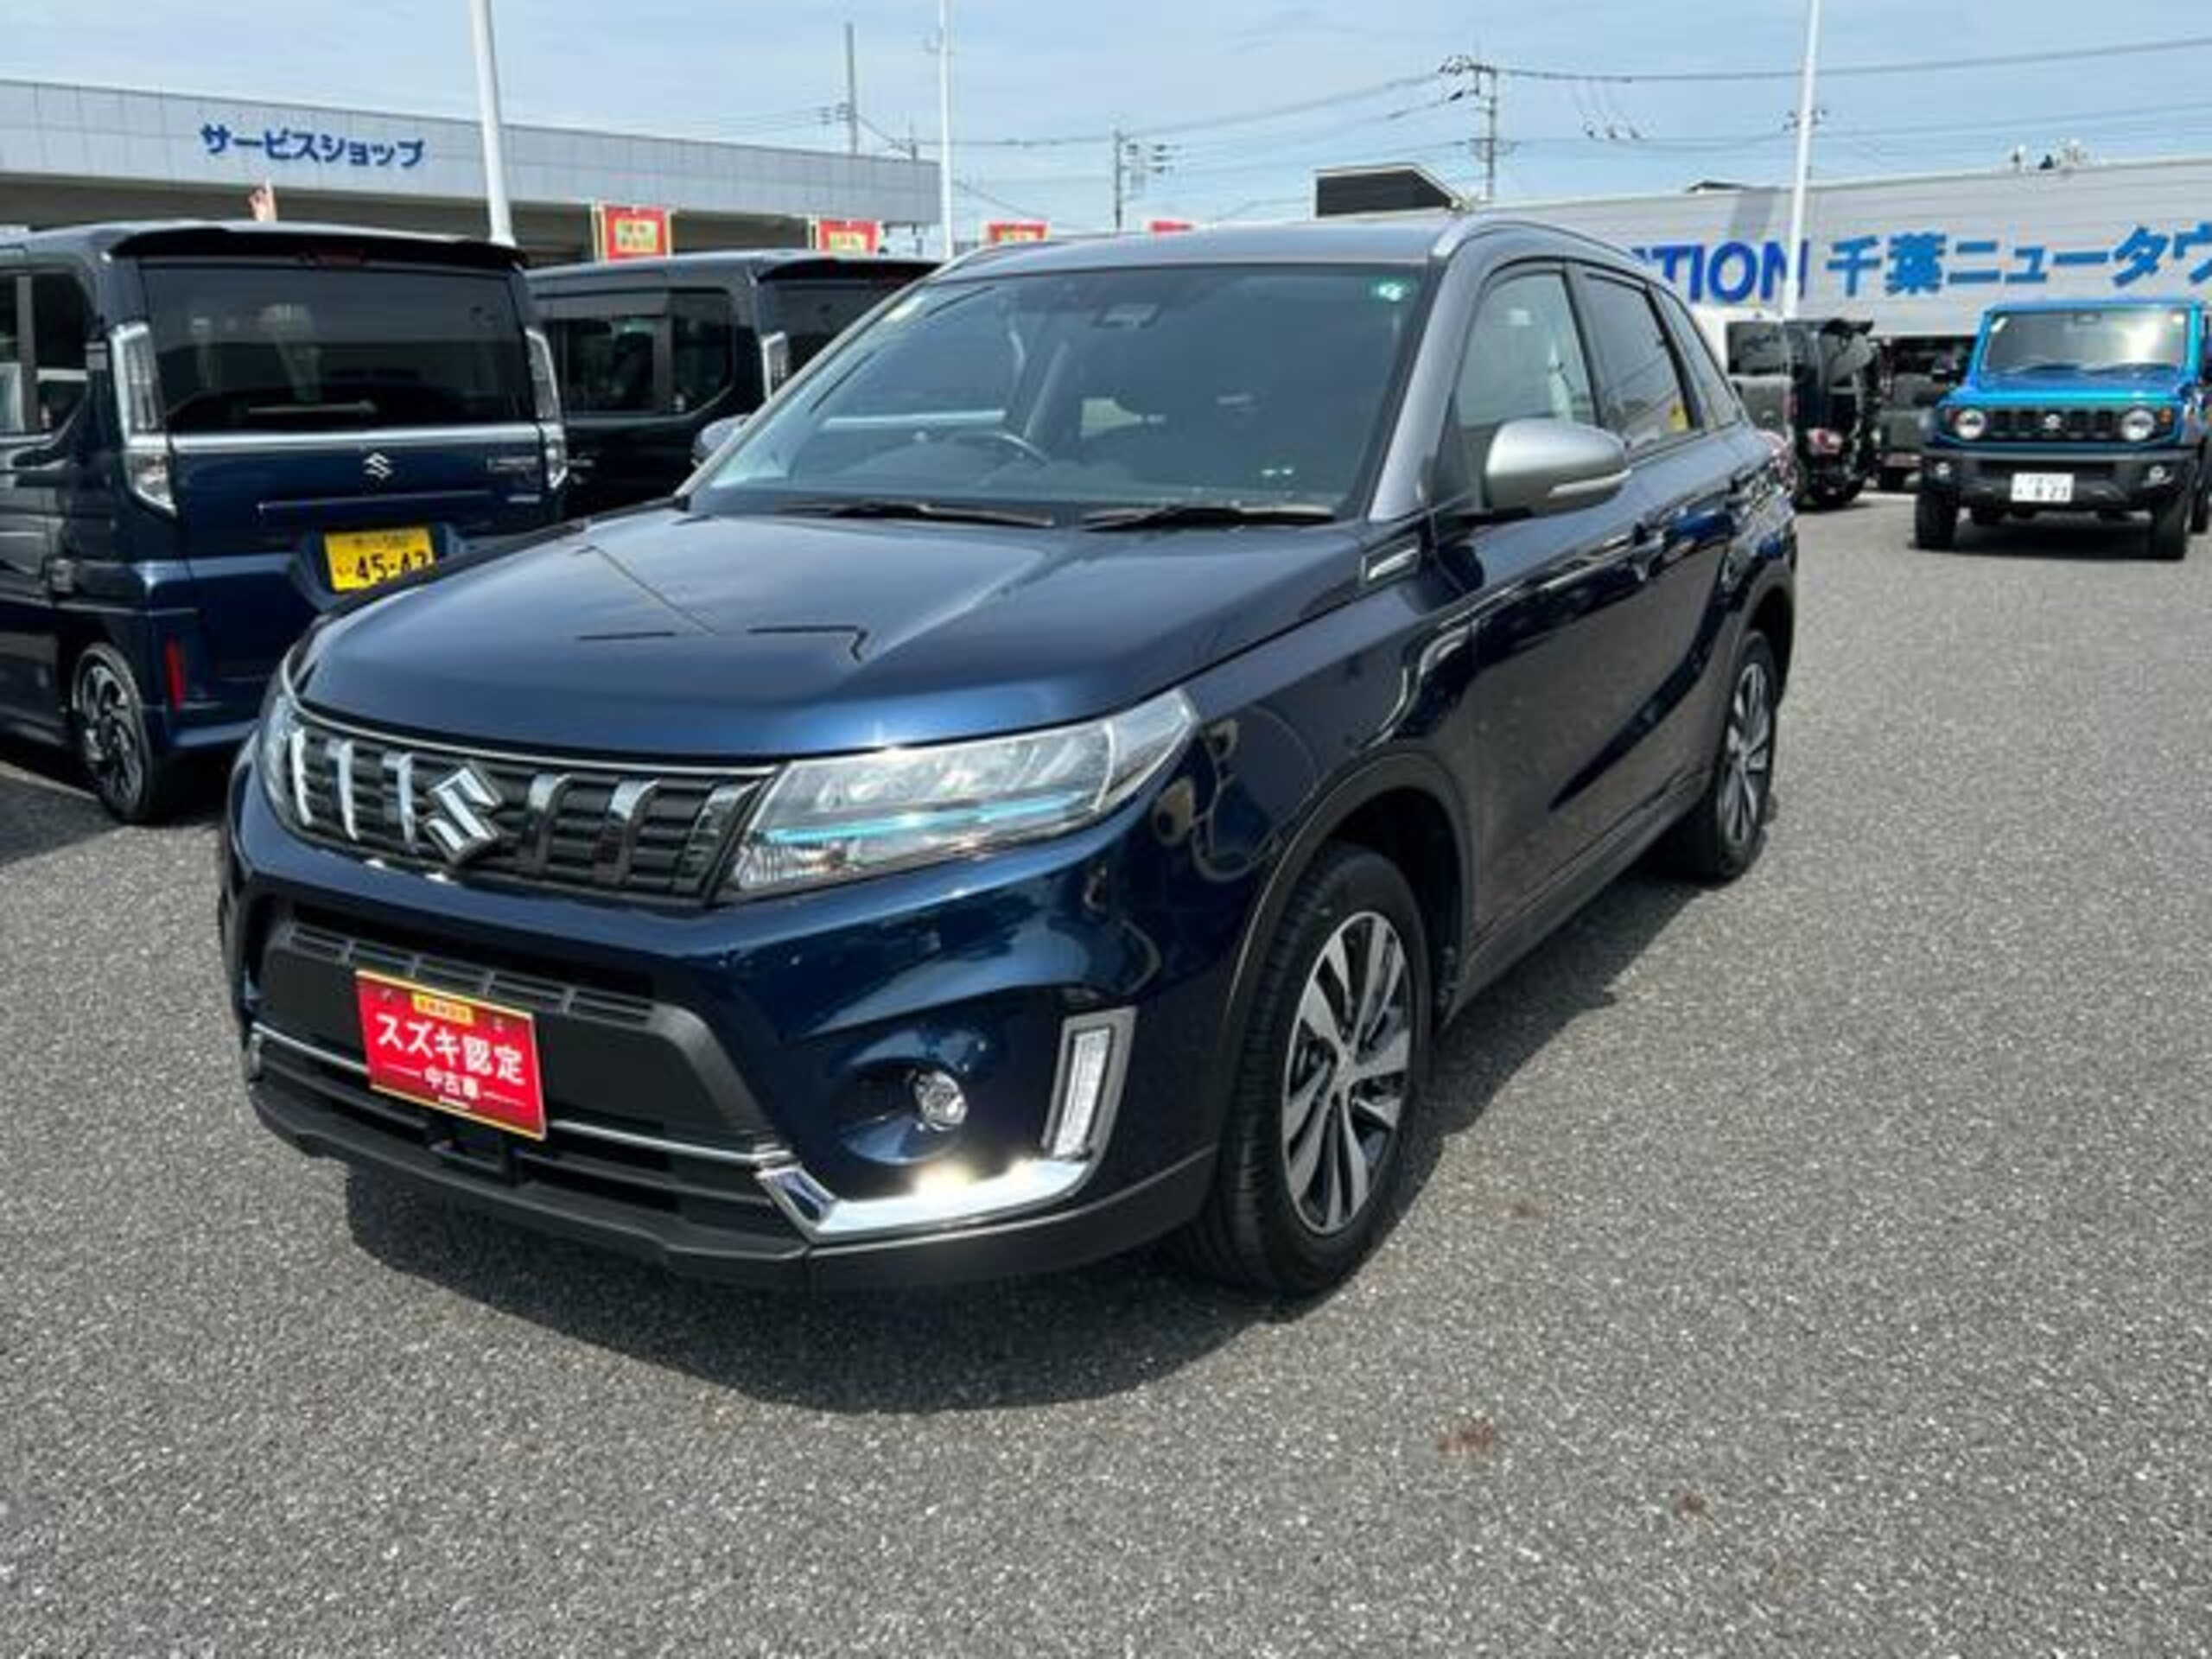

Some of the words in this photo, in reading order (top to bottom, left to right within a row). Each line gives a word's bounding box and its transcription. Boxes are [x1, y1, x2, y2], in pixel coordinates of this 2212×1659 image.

[200, 124, 424, 167] サービスショップ
[1631, 238, 1808, 302] TION
[376, 1013, 525, 1086] スズキ認定
